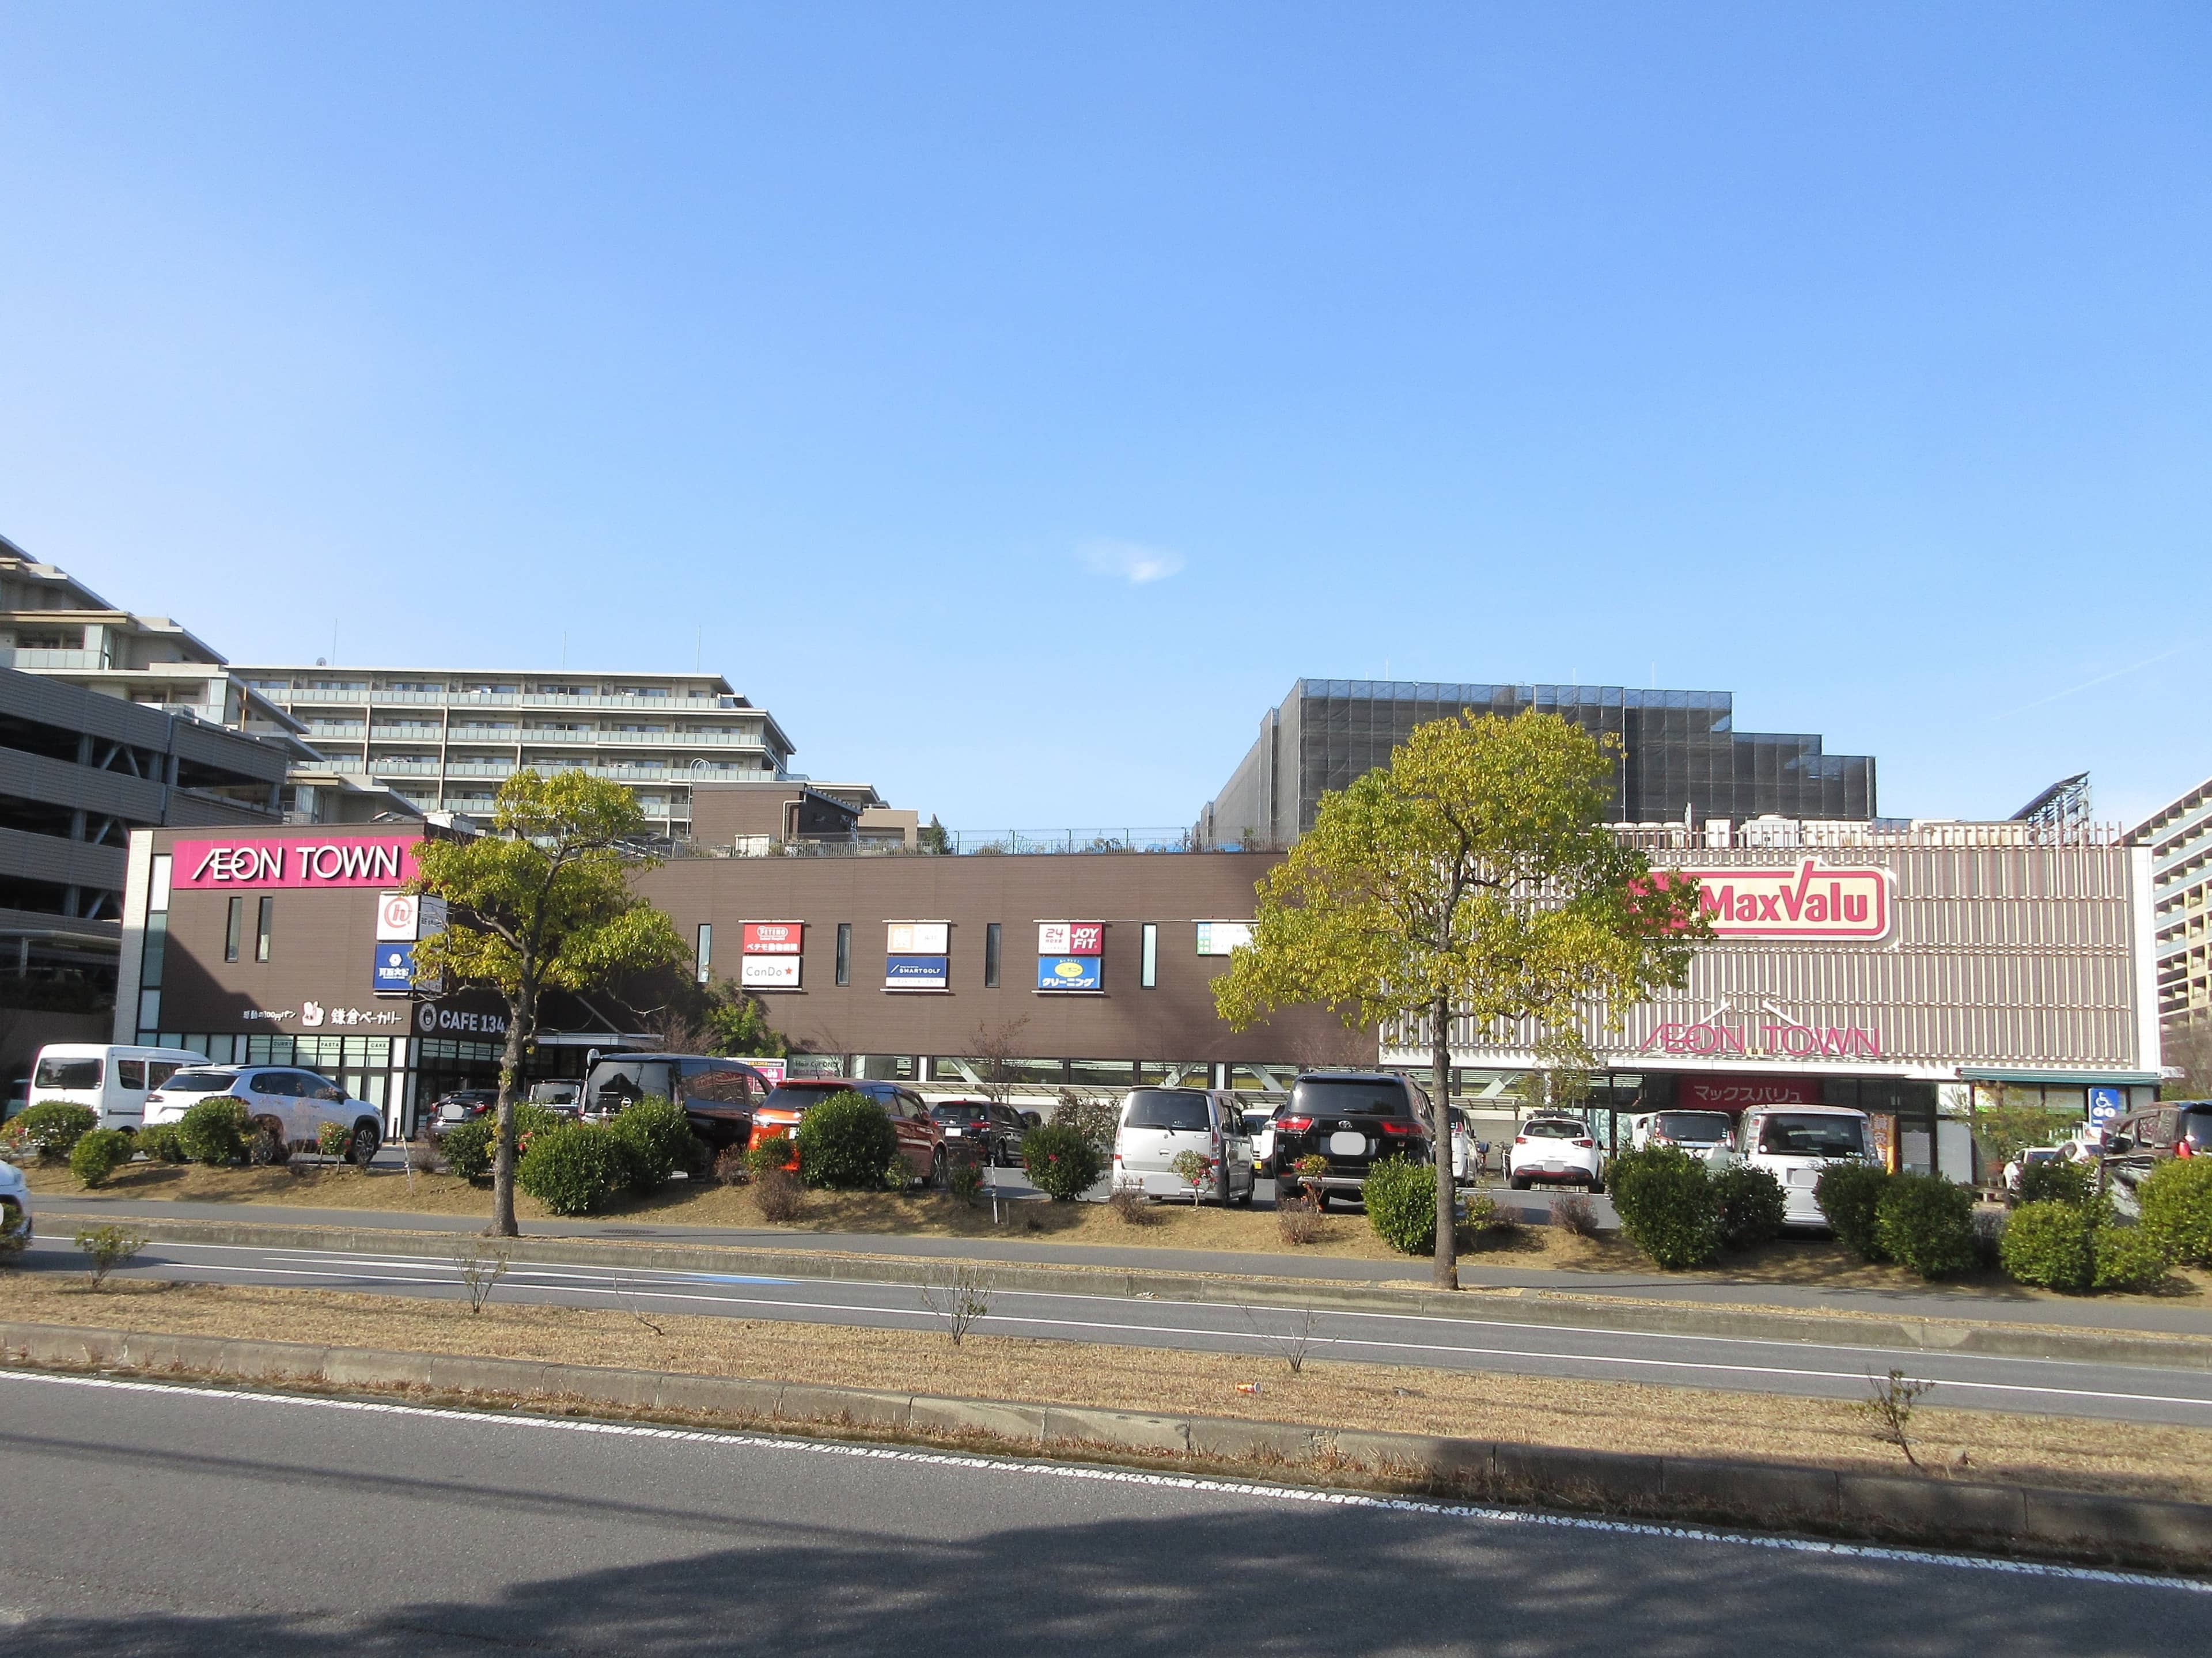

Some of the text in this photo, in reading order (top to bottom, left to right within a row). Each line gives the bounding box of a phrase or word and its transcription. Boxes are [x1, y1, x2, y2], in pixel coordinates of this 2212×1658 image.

[296, 845, 399, 879] TOWN
[1700, 861, 1867, 921] MaxValu
[1046, 928, 1063, 938] 24
[1071, 928, 1100, 939] JOY
[746, 966, 782, 976] CanDo
[1042, 977, 1095, 987] クリーニング
[331, 1007, 403, 1025] 鎌倉ベーカリー
[440, 1010, 478, 1031] CAFE
[480, 1014, 506, 1034] 134
[1760, 1025, 1880, 1057] TOWN
[1694, 1085, 1803, 1103] マックスバリュ
